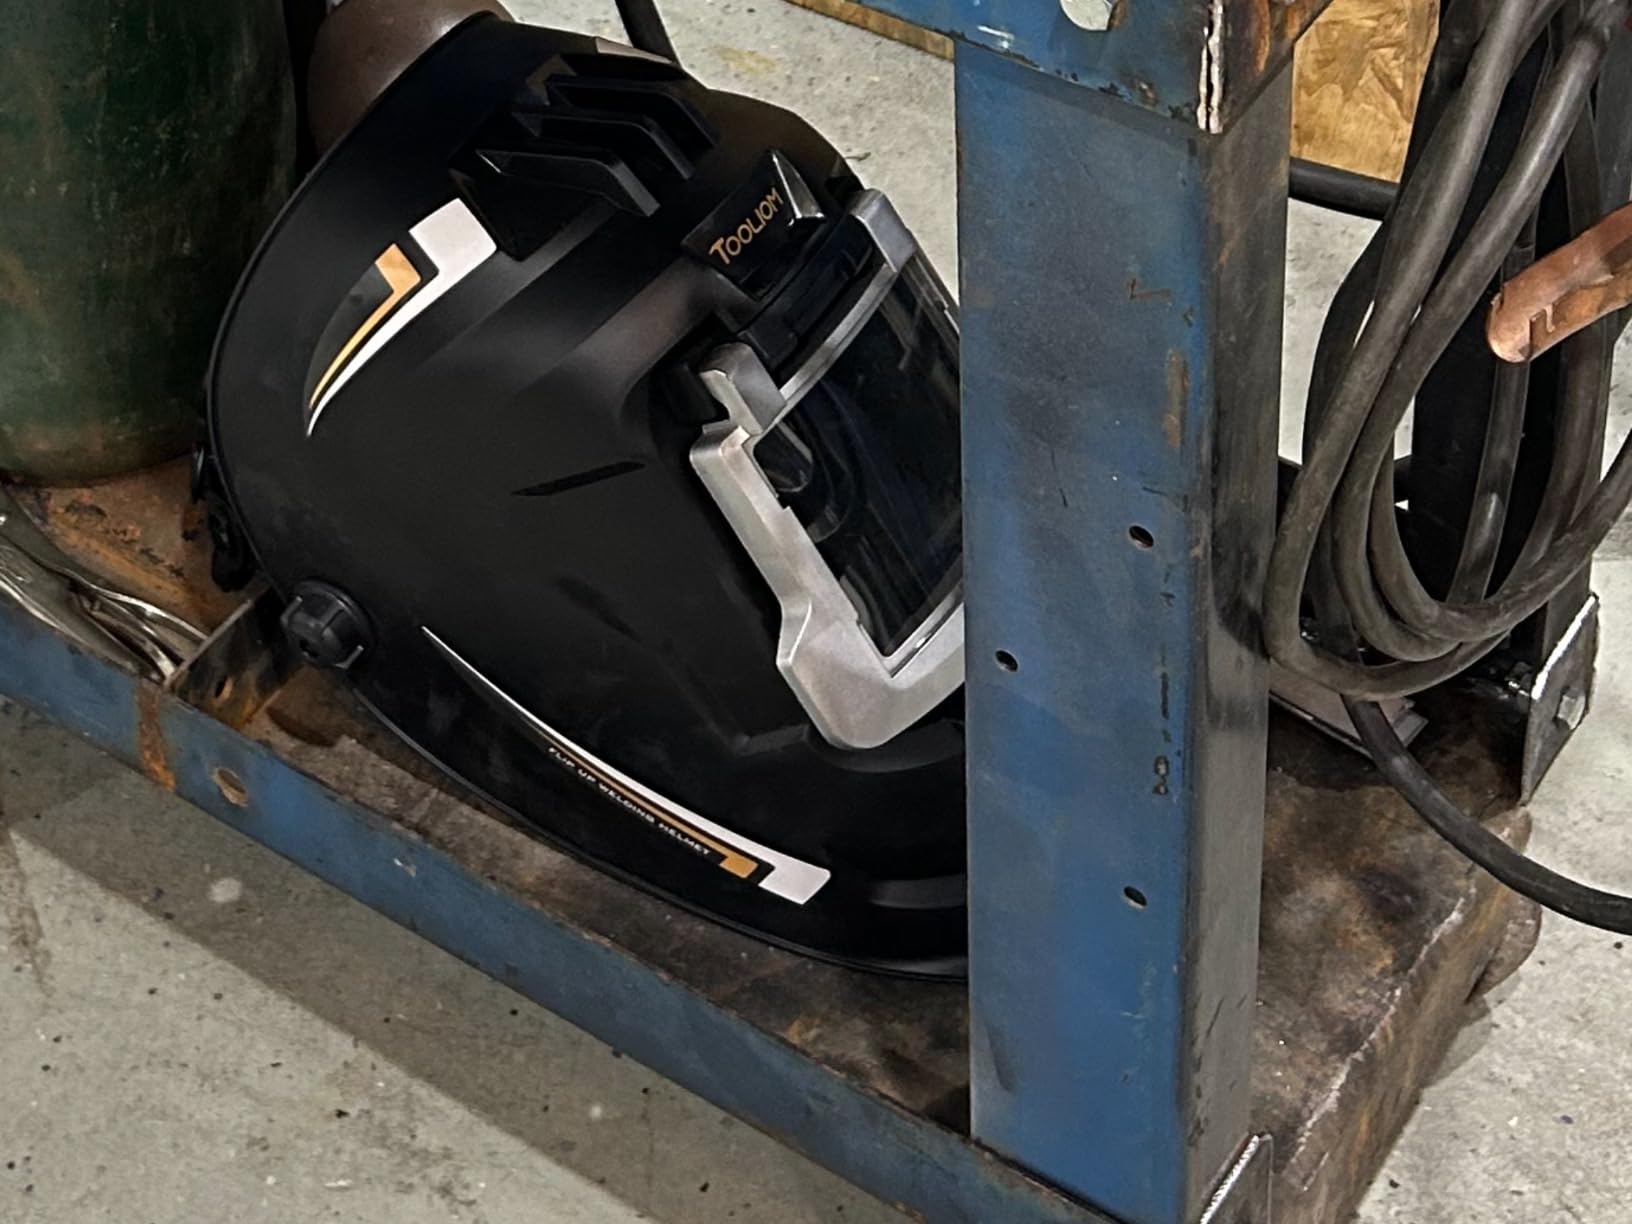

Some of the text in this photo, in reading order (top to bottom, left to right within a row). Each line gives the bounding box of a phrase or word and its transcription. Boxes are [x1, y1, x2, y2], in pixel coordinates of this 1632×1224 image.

[708, 187, 784, 264] TOOLIOM
[548, 747, 710, 855] FLIP UP WELDING HELMET
